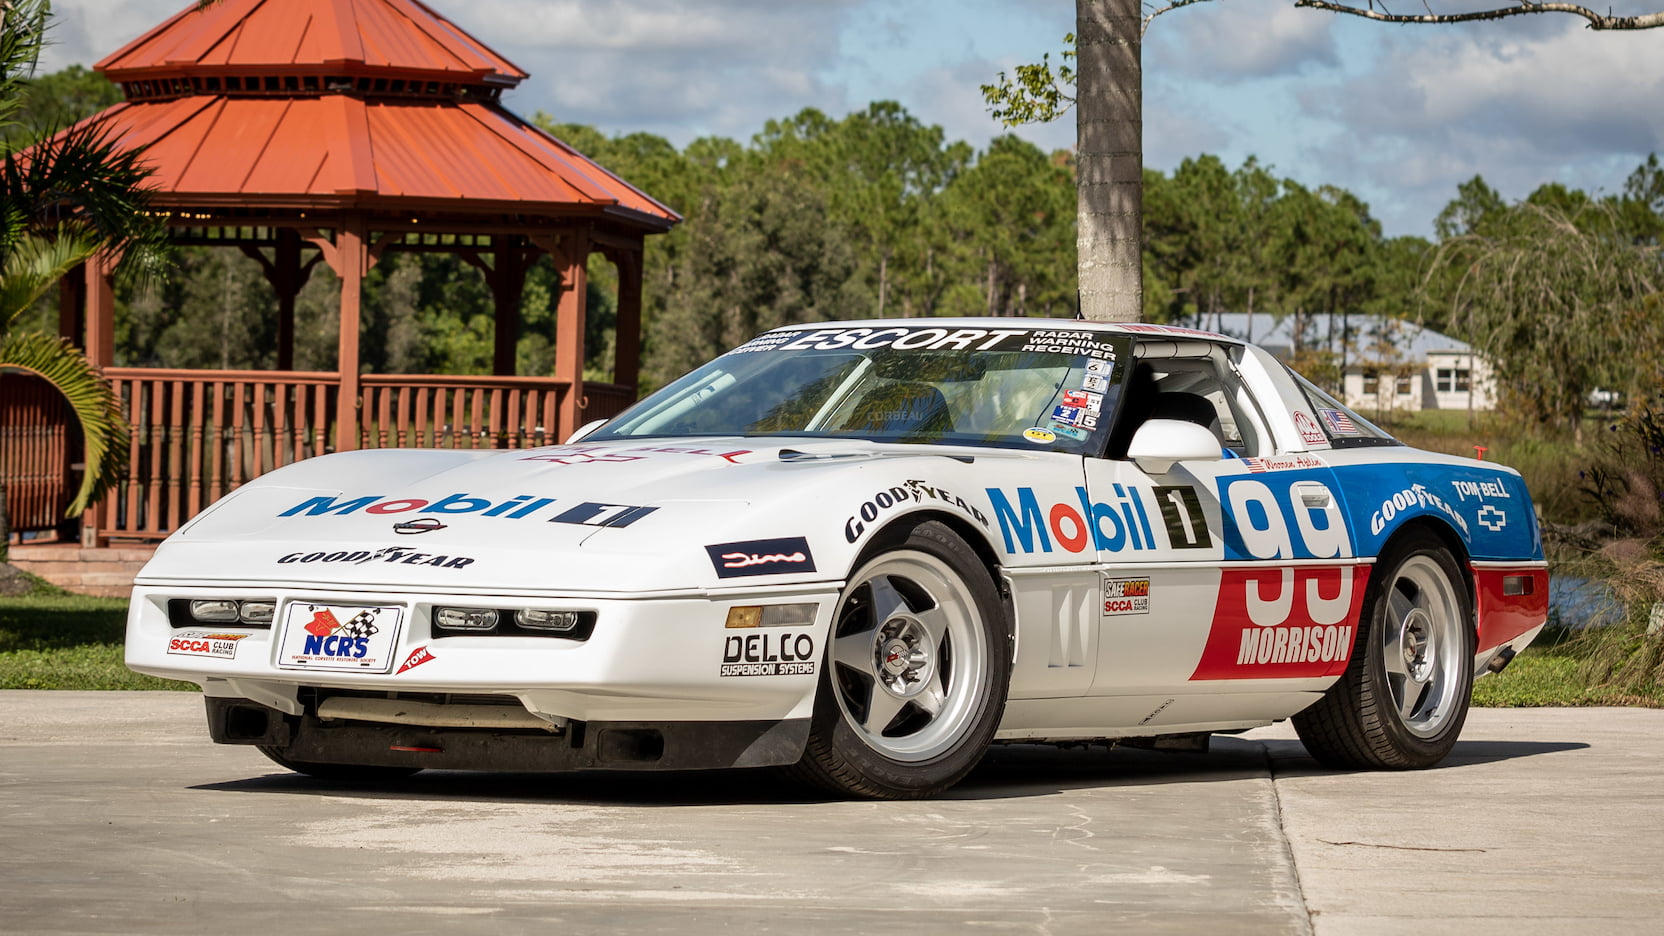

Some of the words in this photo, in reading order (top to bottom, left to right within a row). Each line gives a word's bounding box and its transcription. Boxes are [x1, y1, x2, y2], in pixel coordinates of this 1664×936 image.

[779, 328, 1027, 350] ESCORT
[1029, 337, 1114, 352] WARNING
[1032, 331, 1094, 340] RADAR
[1021, 344, 1117, 361] RECEIVER
[1451, 480, 1484, 502] TOM
[1480, 477, 1511, 499] BELL
[277, 494, 557, 519] Mobil
[845, 480, 990, 544] GOODYEAR
[1371, 484, 1471, 542] GOODYEAR
[985, 483, 1156, 555] Mobil
[277, 546, 475, 569] GOODYEAR
[1227, 480, 1353, 626] 99
[1104, 599, 1133, 612] SCCA
[1133, 598, 1148, 606] CLUB
[170, 638, 210, 653] SCCA
[211, 648, 234, 656] RACING
[213, 641, 235, 650] CLUB
[303, 635, 370, 658] NCRS
[723, 633, 814, 663] DELCO
[1236, 625, 1352, 665] MORRISON
[404, 646, 428, 670] TOW
[721, 664, 776, 676] SUSPENSION
[778, 662, 815, 675] SYSTEMS
